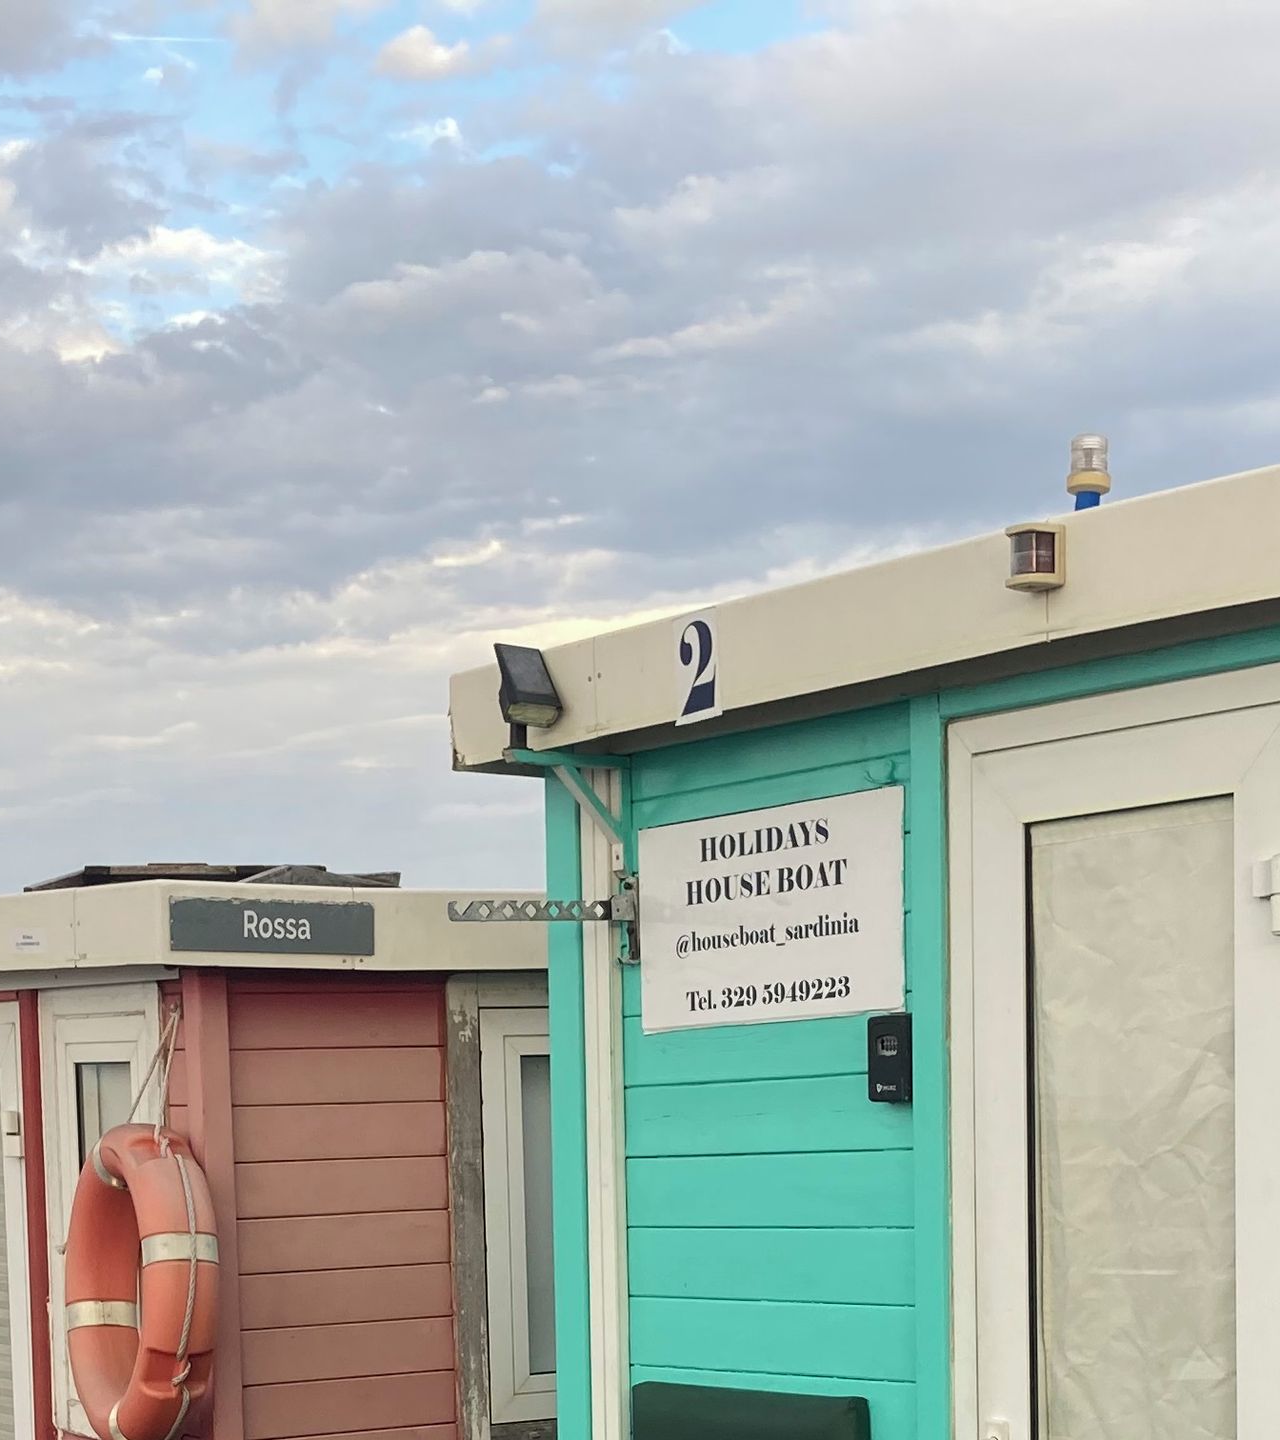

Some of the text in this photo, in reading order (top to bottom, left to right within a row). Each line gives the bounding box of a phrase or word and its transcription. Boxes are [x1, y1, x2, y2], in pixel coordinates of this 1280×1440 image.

[679, 620, 717, 717] 2
[699, 817, 830, 863] HOLIDAYS
[685, 858, 848, 906] HOUSE BOAT
[242, 909, 312, 940] Rossa
[675, 911, 860, 960] @houseboat_sardinia
[686, 975, 851, 1012] Tel. 329 5949223
